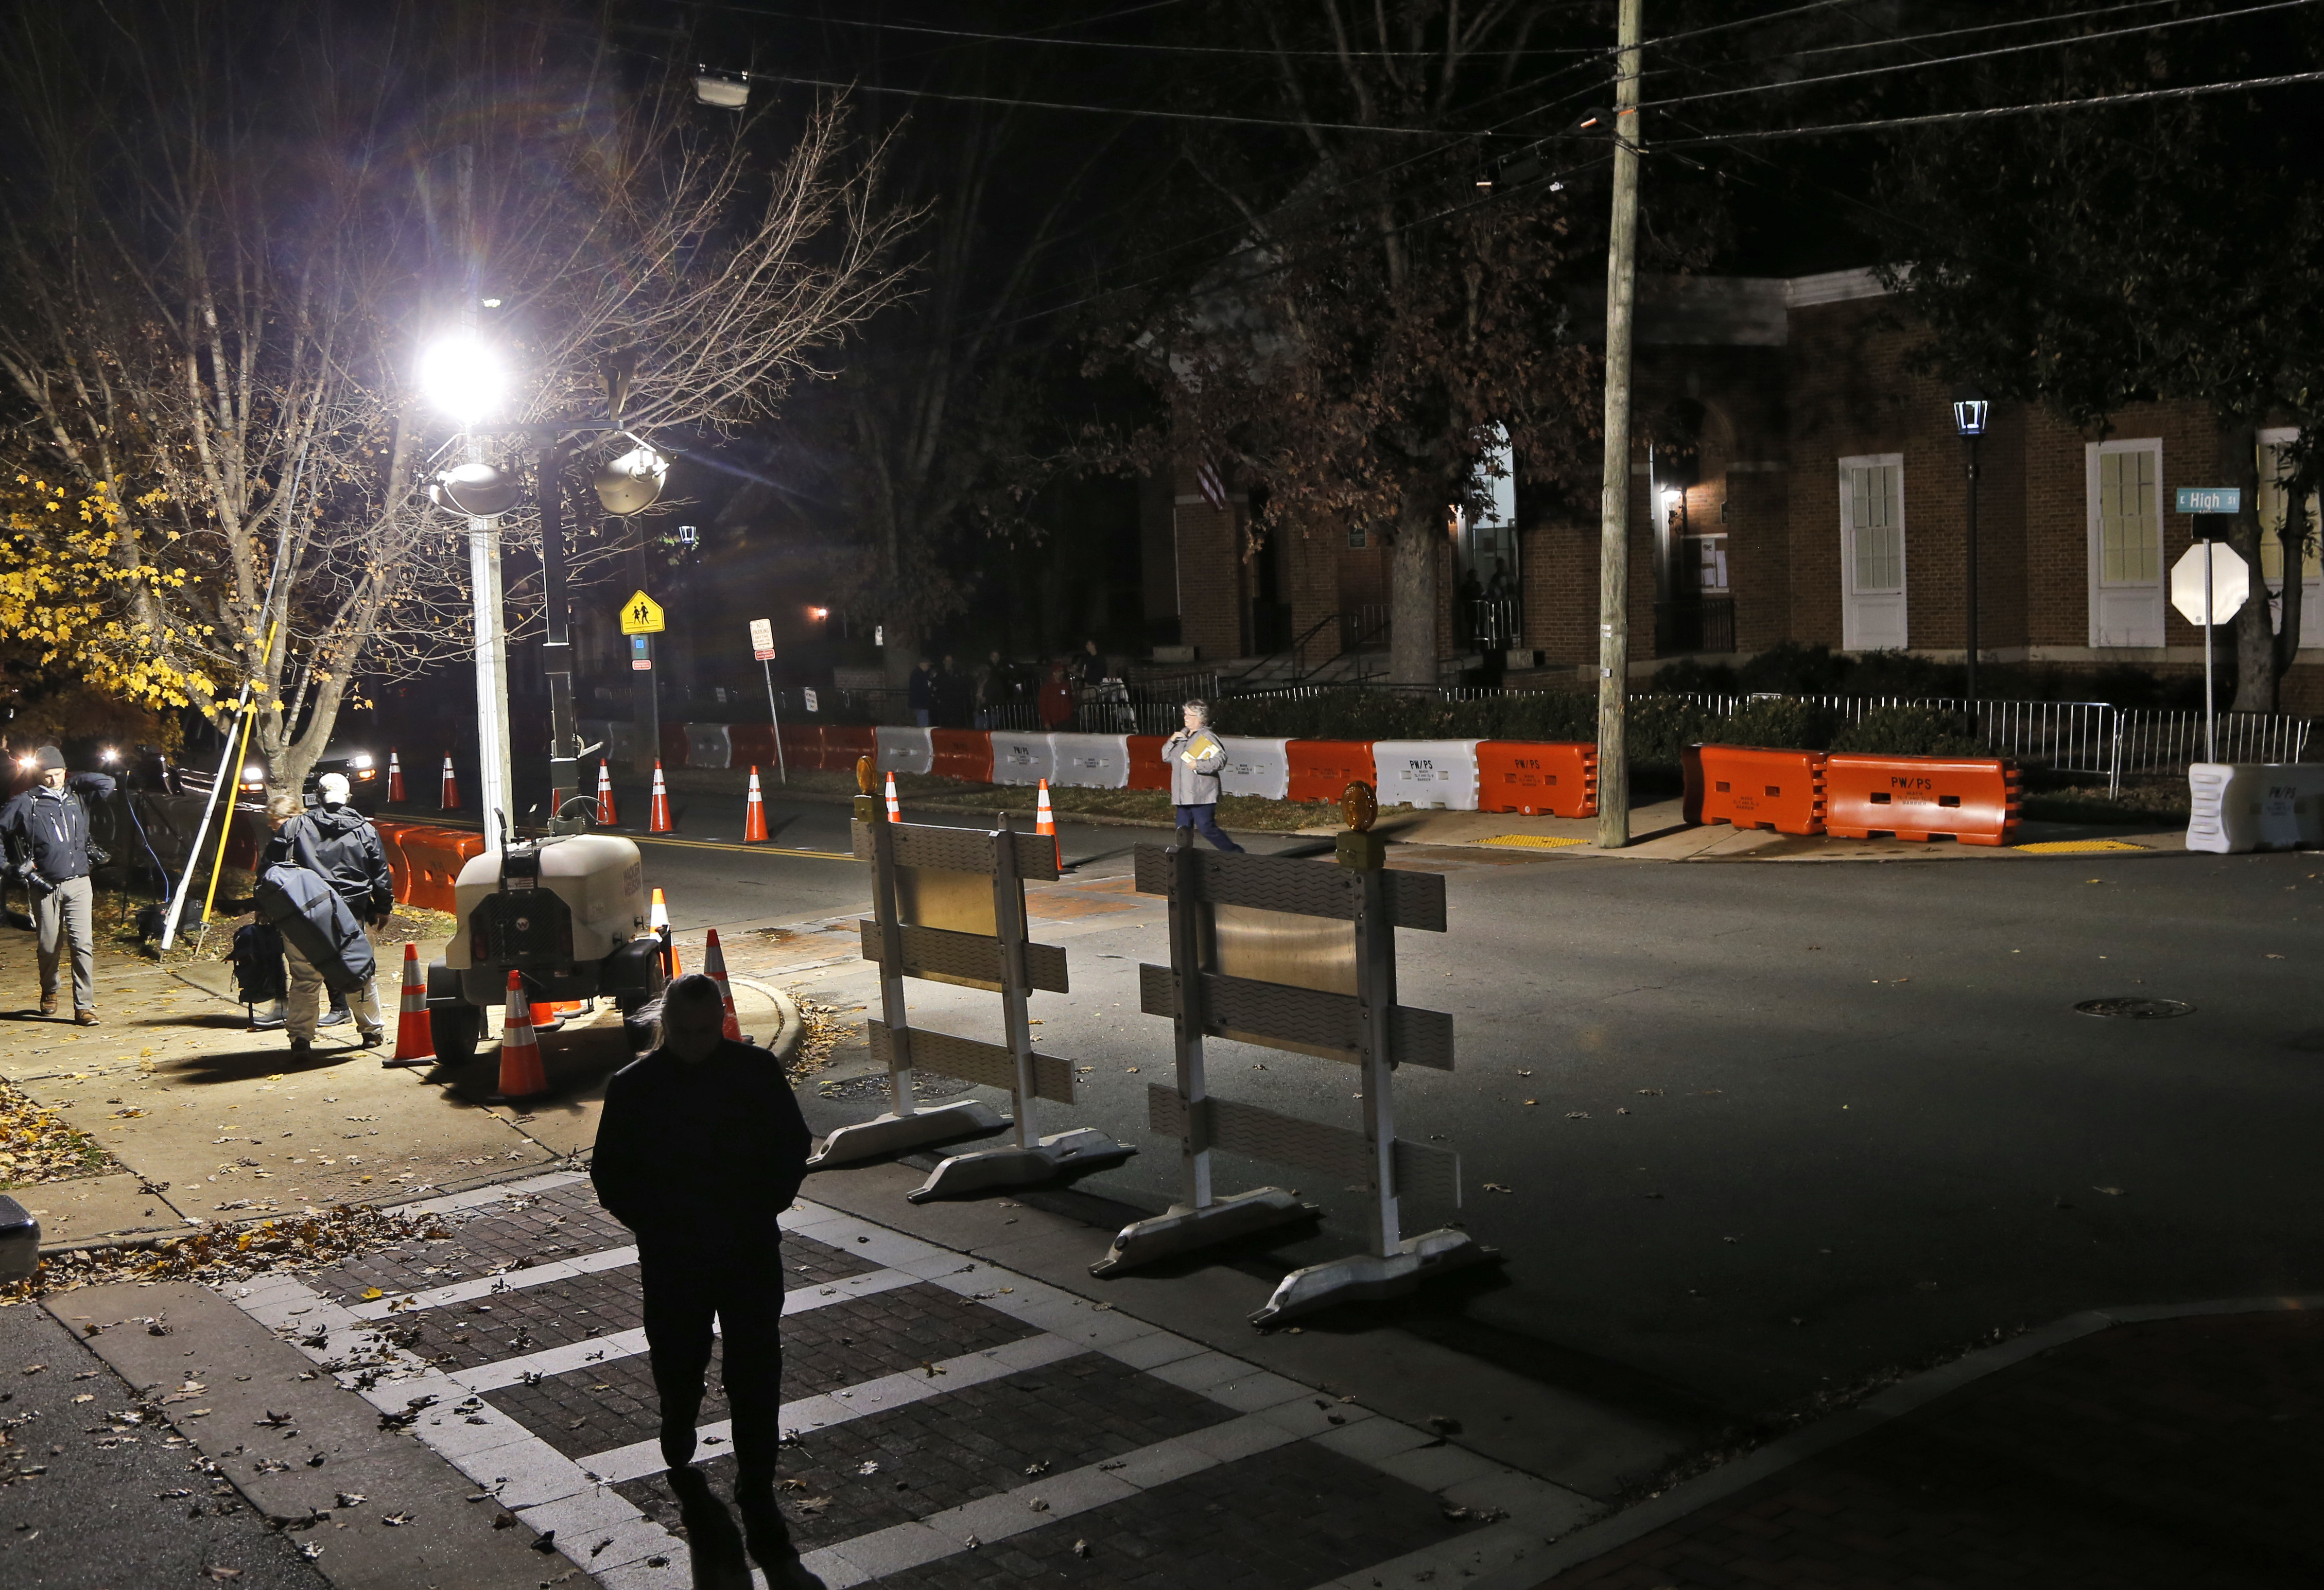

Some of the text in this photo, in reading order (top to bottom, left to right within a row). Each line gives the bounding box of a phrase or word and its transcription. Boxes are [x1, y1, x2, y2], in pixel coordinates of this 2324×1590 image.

[2180, 492, 2236, 511] E High St
[1410, 760, 1433, 770] PW/PS
[1515, 759, 1540, 769] PW/PS
[1892, 777, 1931, 790] PW/PS
[2269, 786, 2296, 798] PW/PS
